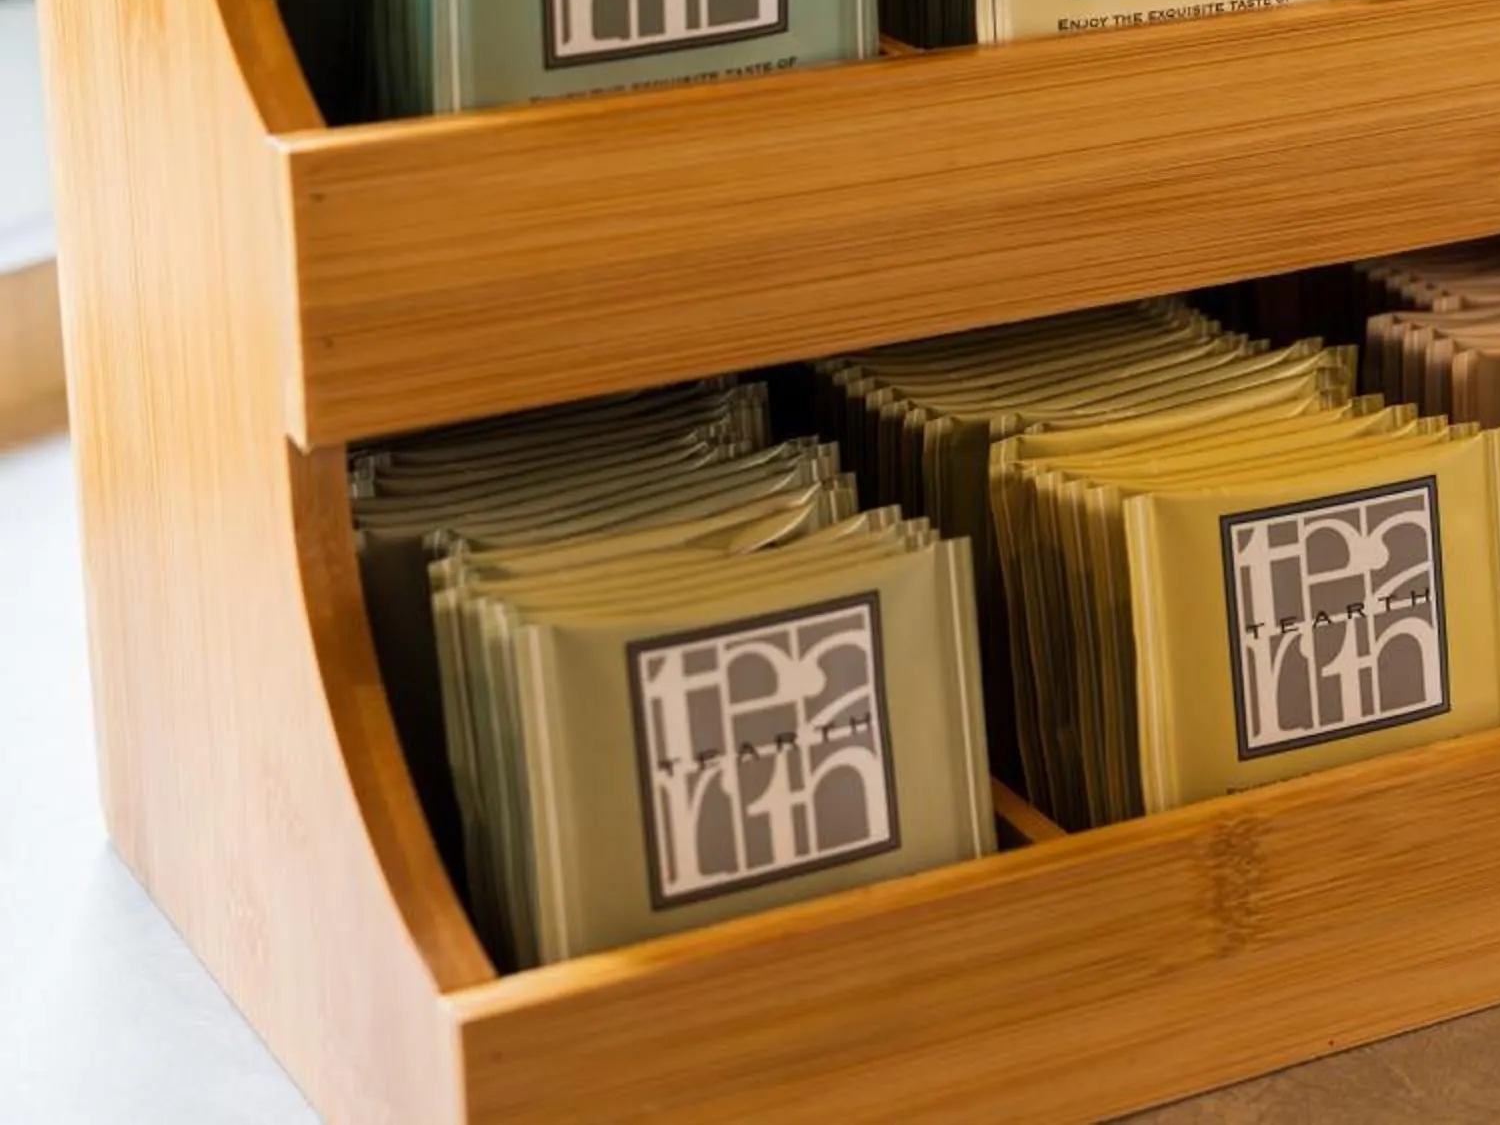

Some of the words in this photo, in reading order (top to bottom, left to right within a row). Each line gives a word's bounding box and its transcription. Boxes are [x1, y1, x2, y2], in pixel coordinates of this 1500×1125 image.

[1058, 17, 1109, 31] ENJOY
[1113, 12, 1143, 26] THE
[1148, 2, 1225, 22] EXQUISITE
[777, 55, 798, 69] OF
[1246, 588, 1430, 640] TEARTH
[658, 712, 872, 776] TEARTH
